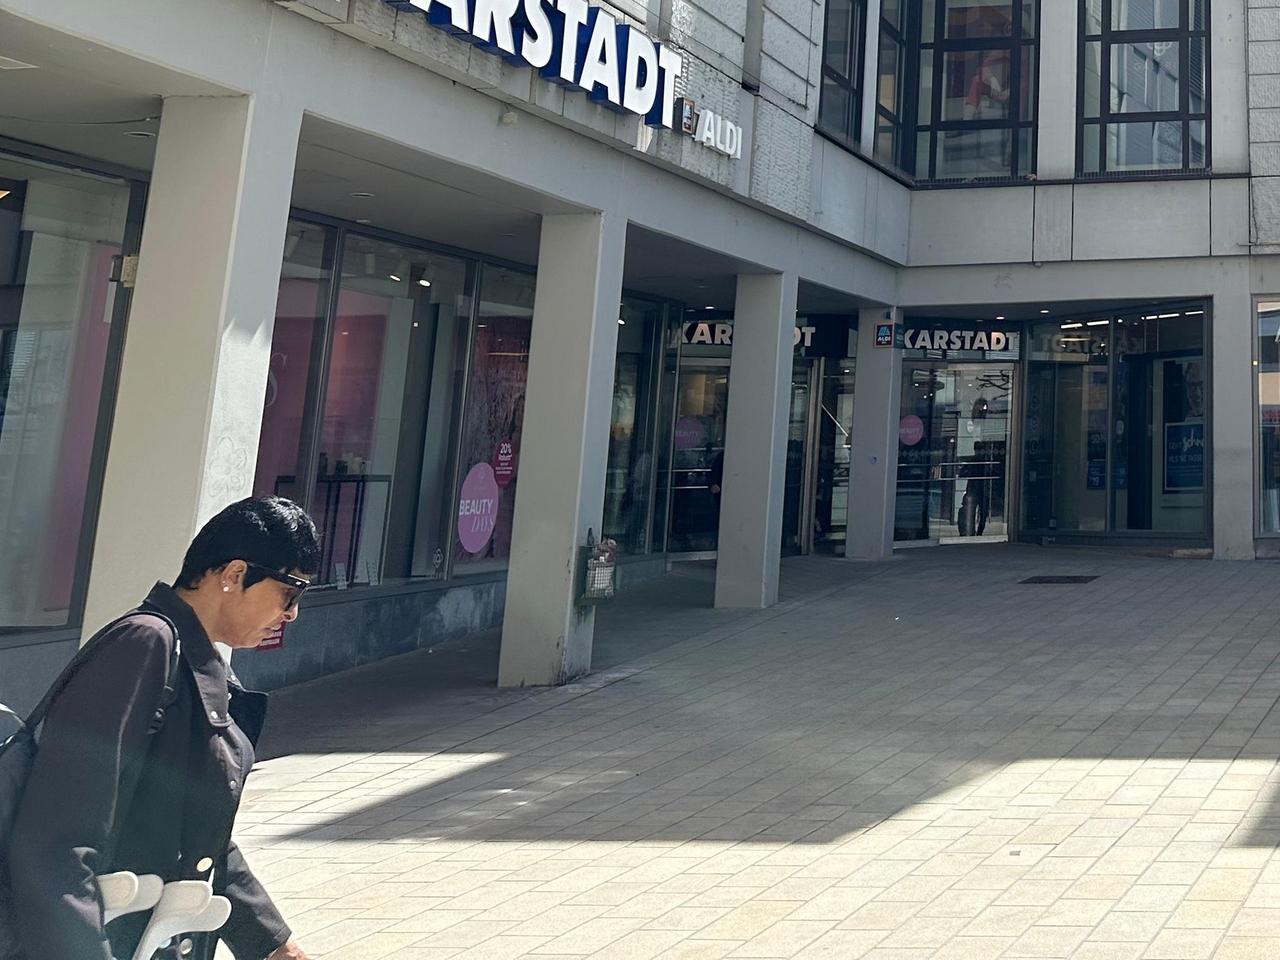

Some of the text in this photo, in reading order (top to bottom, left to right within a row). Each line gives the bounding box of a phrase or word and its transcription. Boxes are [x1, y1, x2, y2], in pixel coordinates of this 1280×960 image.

[697, 109, 742, 159] ALDI
[904, 328, 1019, 351] KARSTADT
[459, 499, 493, 515] BEAUTY
